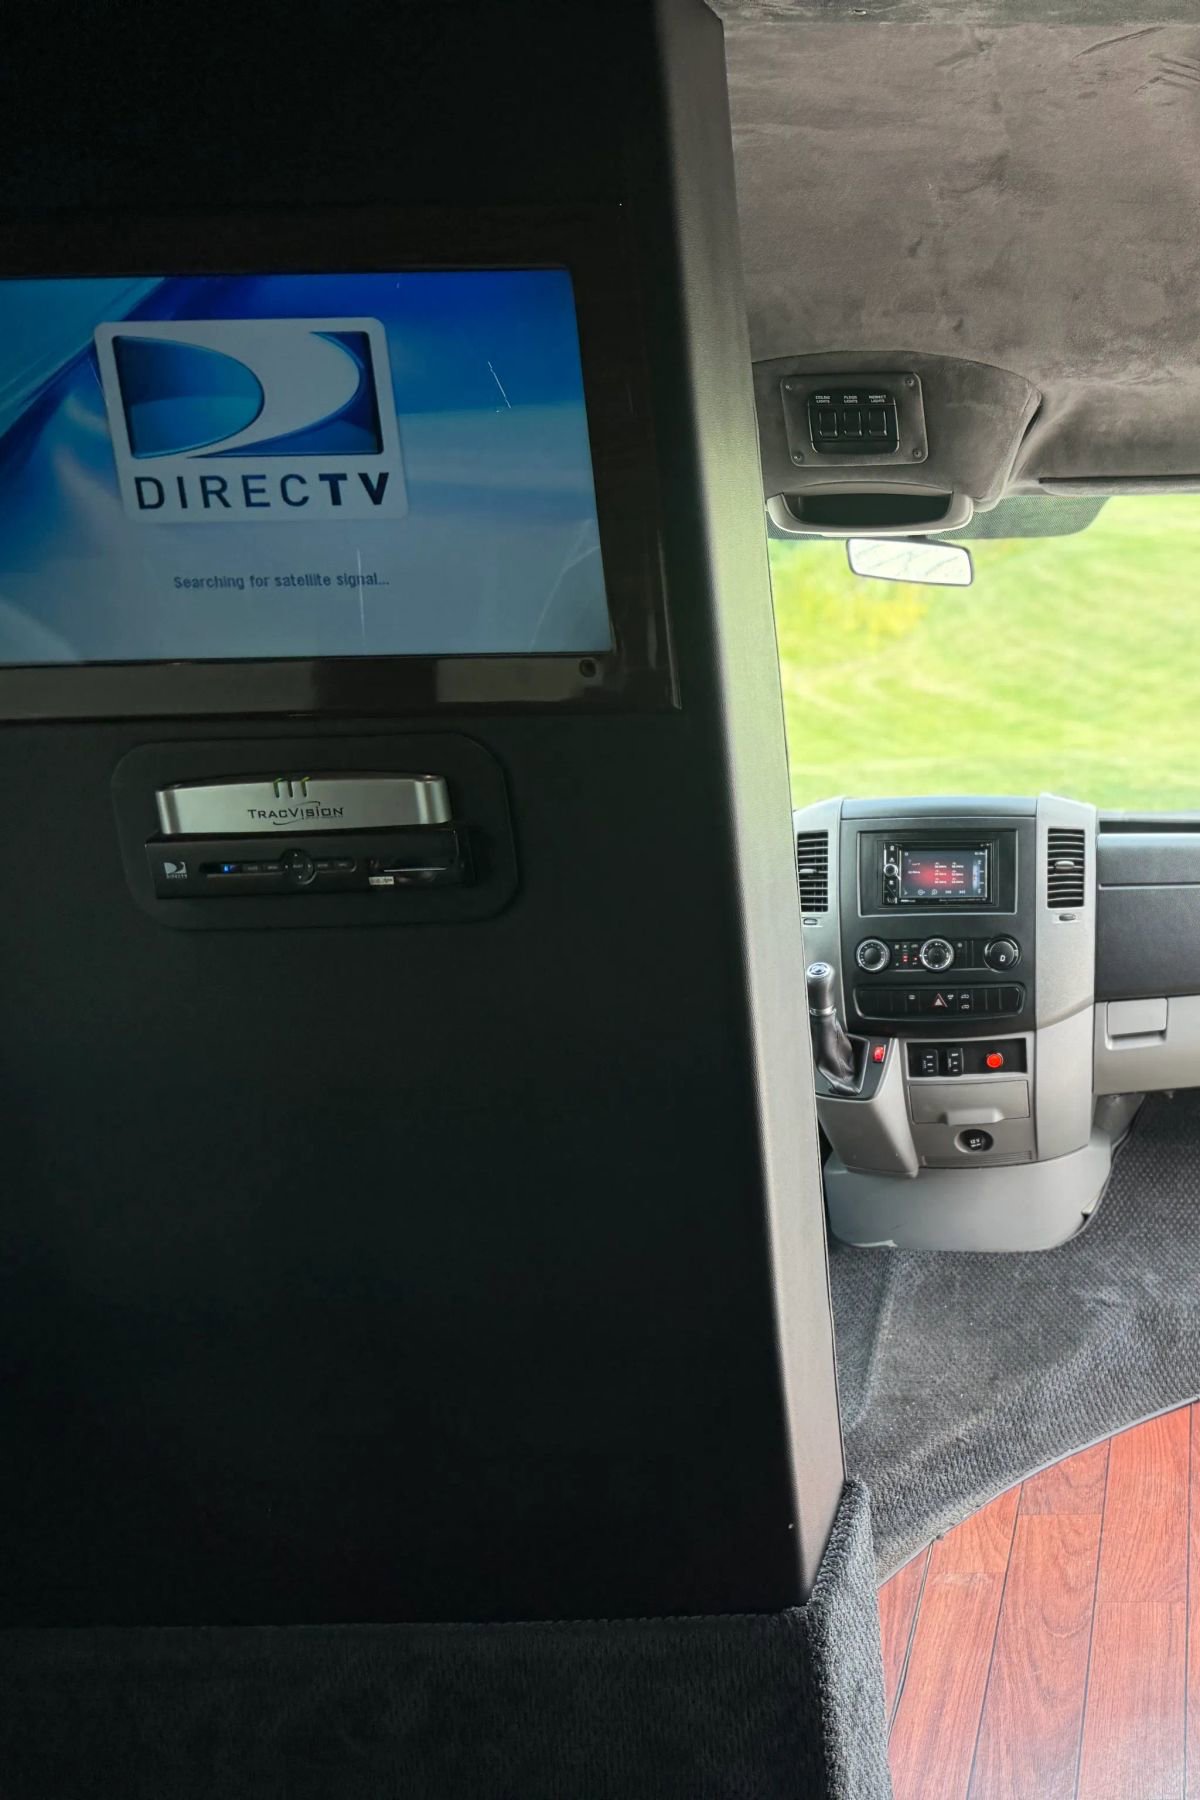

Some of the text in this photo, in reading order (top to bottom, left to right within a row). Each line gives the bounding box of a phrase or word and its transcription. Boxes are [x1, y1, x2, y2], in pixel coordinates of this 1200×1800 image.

[134, 472, 390, 510] DIRECTV
[173, 572, 390, 590] Searching for satellite signal...
